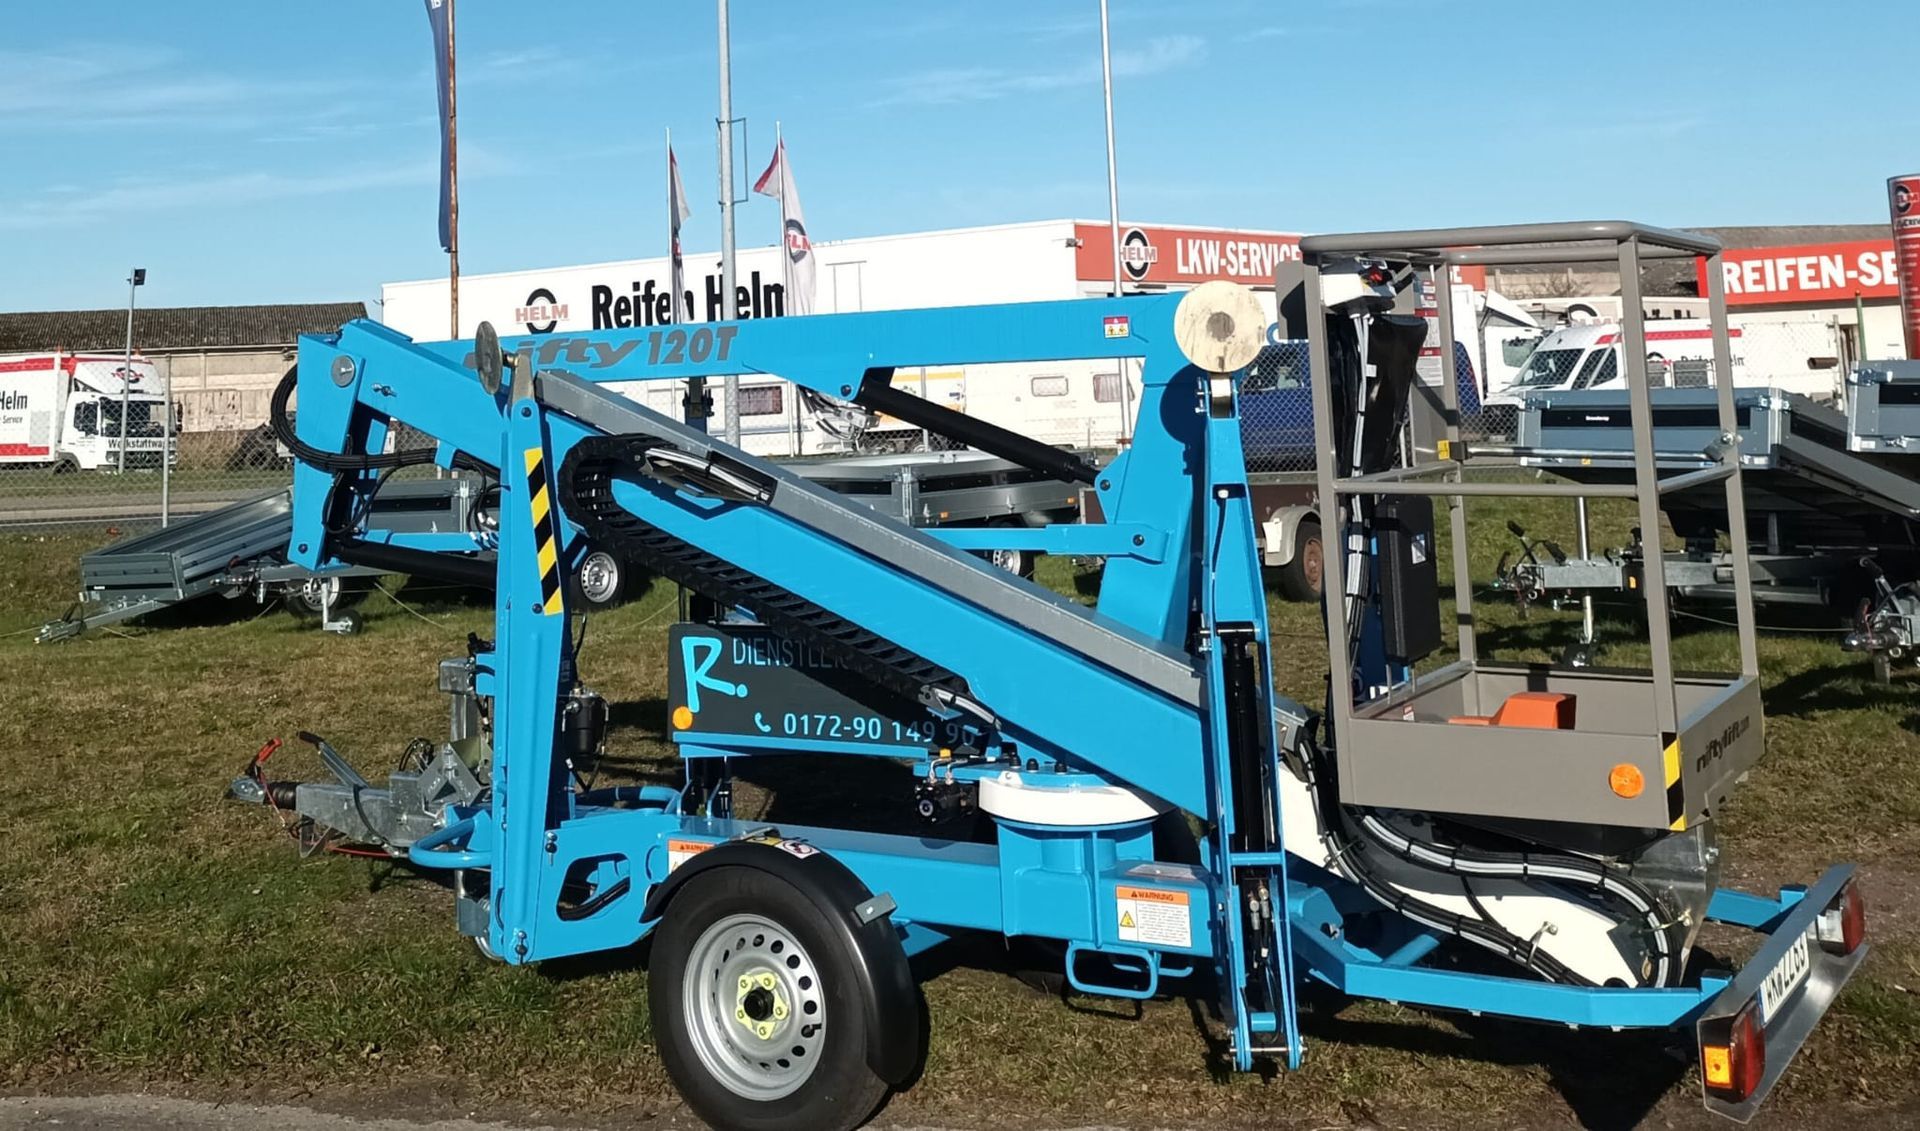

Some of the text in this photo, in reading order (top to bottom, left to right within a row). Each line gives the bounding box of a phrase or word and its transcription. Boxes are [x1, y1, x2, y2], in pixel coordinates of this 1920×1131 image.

[515, 303, 569, 322] HELM
[648, 326, 739, 366] 120T
[784, 712, 976, 746] 0172-90 149 90
